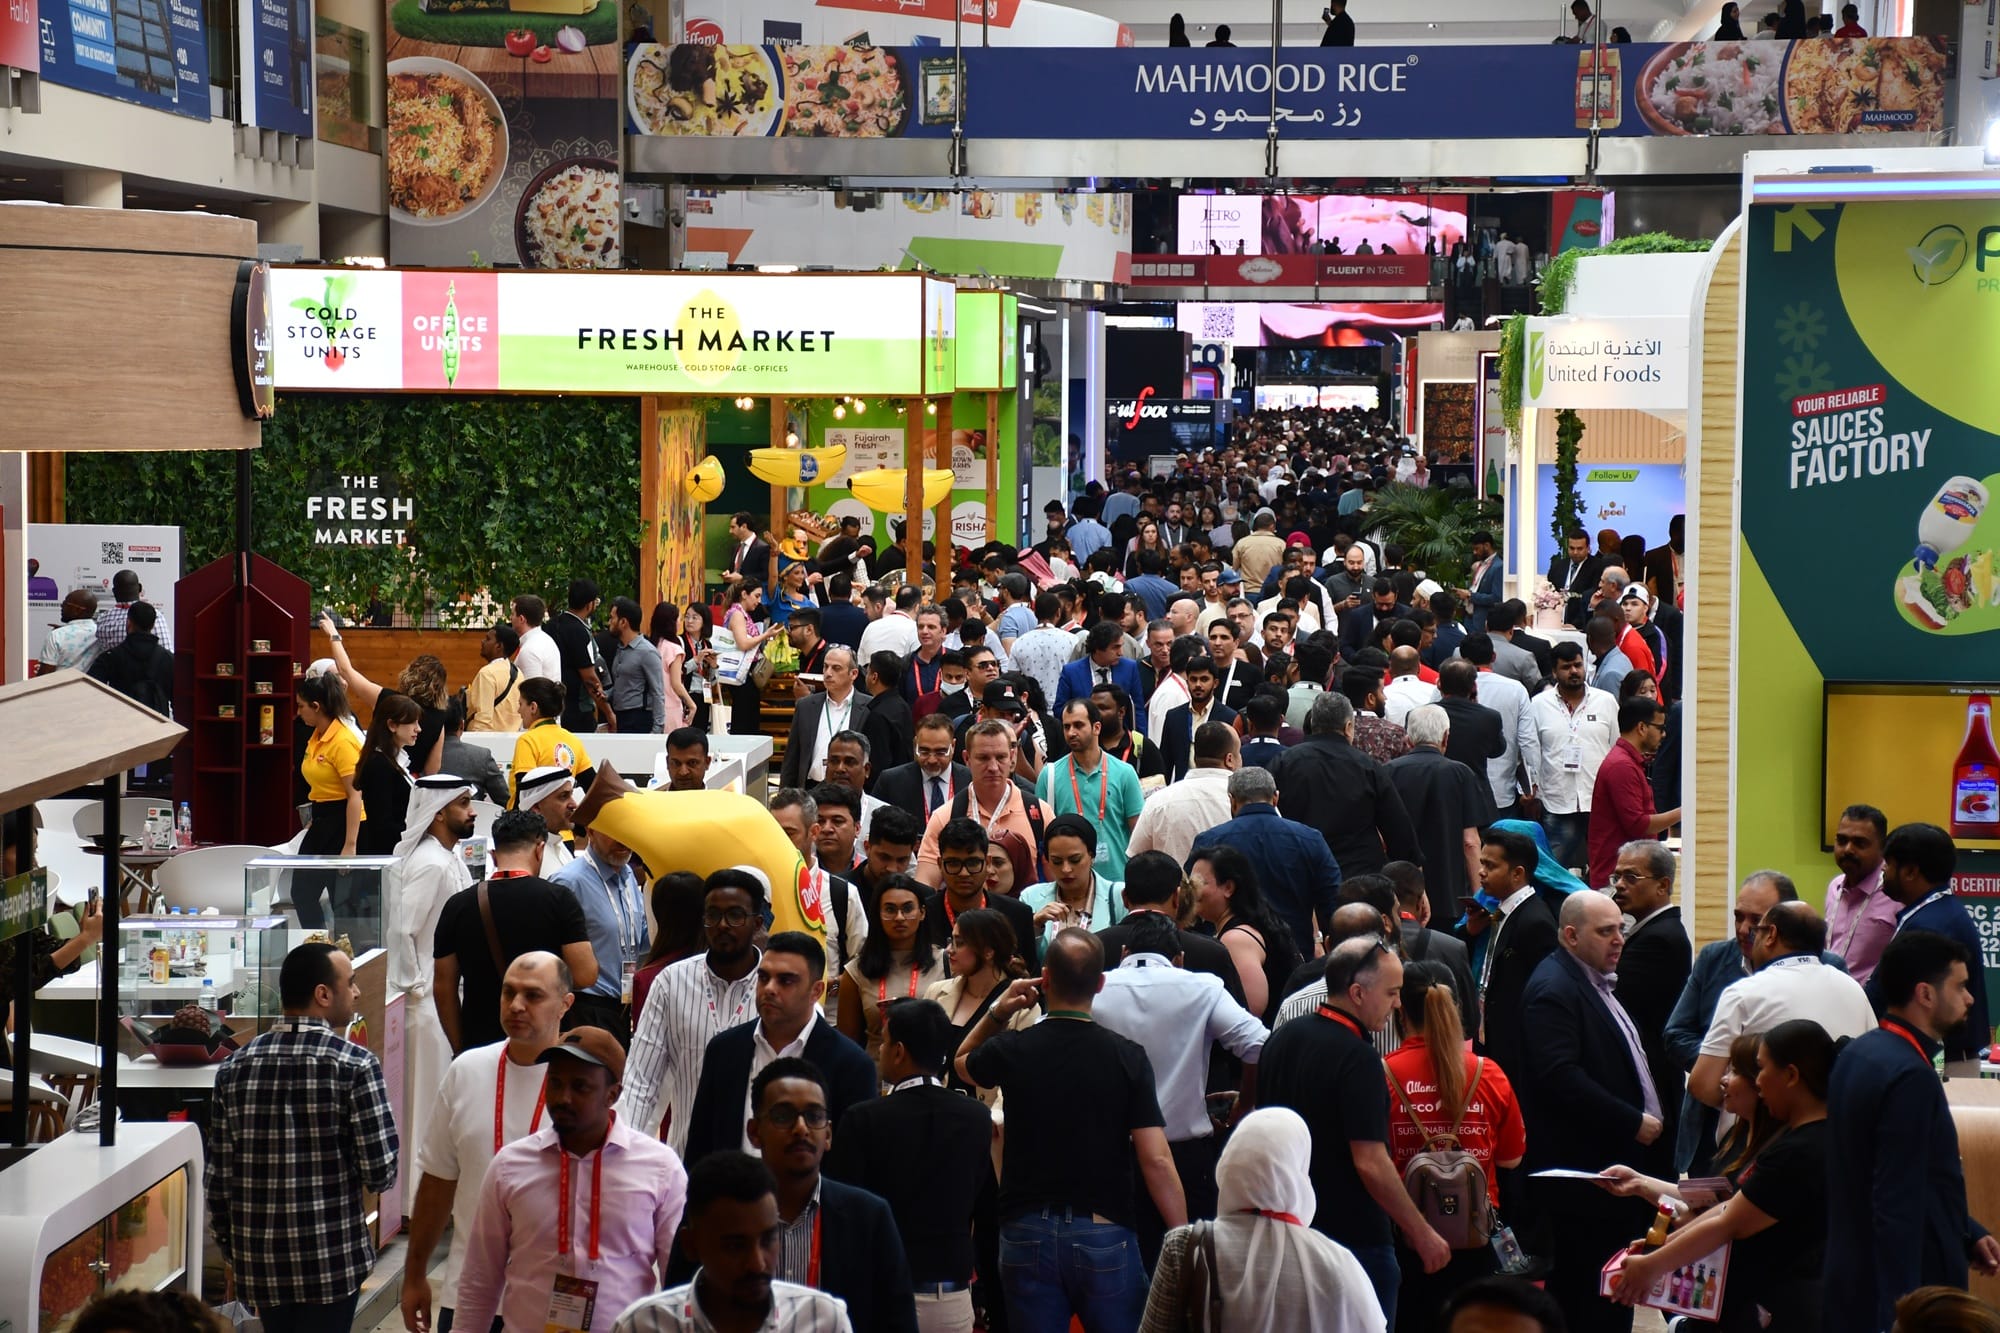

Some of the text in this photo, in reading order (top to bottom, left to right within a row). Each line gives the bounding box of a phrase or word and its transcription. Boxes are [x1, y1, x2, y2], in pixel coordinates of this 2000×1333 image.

[1135, 64, 1326, 93] MAHMOOD
[1189, 102, 1362, 132] رز محمود
[1864, 112, 1914, 122] MAHMOOD
[1326, 266, 1405, 275] FLUENT IN TASTE
[305, 307, 358, 321] COLD
[689, 307, 725, 319] THE
[413, 315, 489, 332] OFFICE
[287, 326, 377, 340] STORAGE
[578, 328, 835, 352] FRESH MARKET
[421, 336, 483, 351] UNITS
[1549, 339, 1661, 360] الأغذية المتحدة
[304, 346, 361, 359] UNITS
[625, 364, 788, 373] WAREHOUSE COLD STORAGE OFFICES
[1548, 364, 1661, 383] United Foods
[1796, 388, 1879, 414] YOUR RELIABLE
[1791, 407, 1884, 450] SAUCES
[854, 433, 891, 444] Fujairah
[1790, 429, 1932, 489] FACTORY
[341, 475, 379, 489] THE
[1594, 472, 1633, 480] Follow Us
[306, 496, 413, 521] FRESH
[315, 528, 407, 545] MARKET
